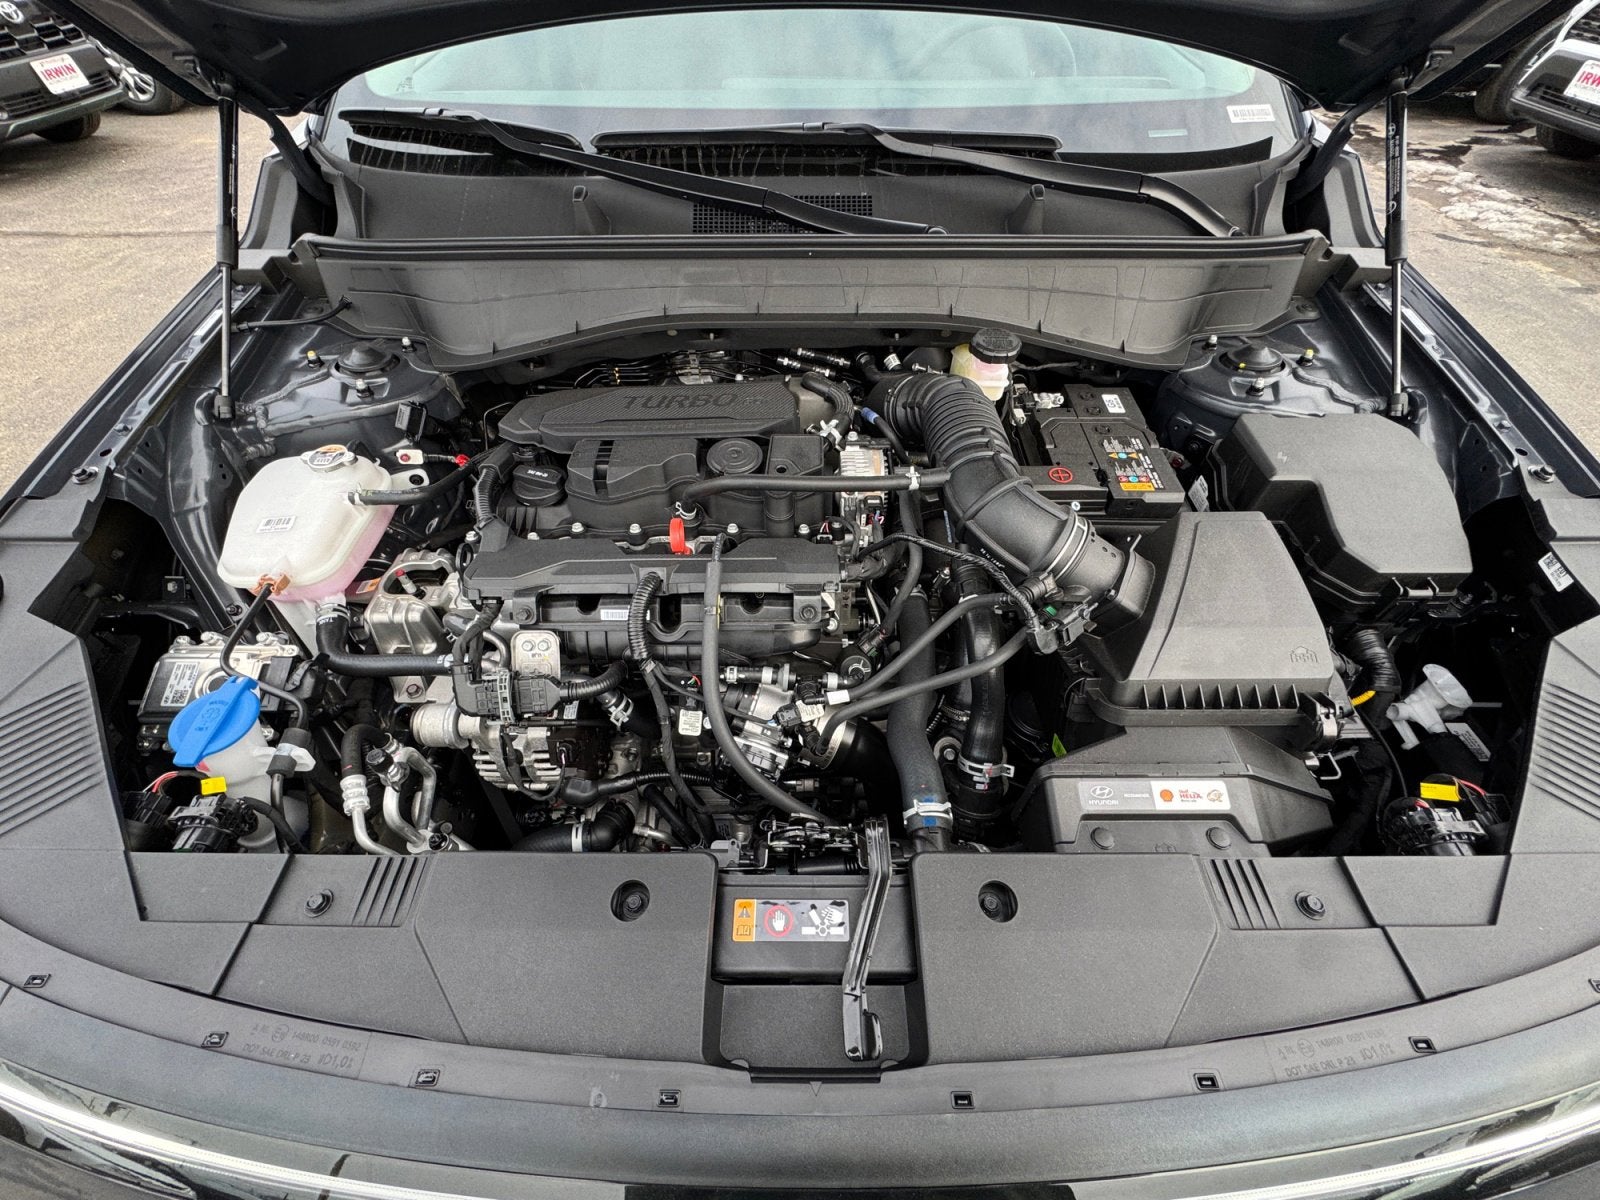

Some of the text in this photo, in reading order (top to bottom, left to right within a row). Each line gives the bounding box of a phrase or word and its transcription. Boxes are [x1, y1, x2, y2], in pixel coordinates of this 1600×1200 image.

[40, 63, 77, 81] IRWIN
[623, 393, 738, 410] TURBO
[260, 1046, 275, 1057] SAE
[1285, 1066, 1303, 1077] DOT
[1303, 1062, 1320, 1073] SAE
